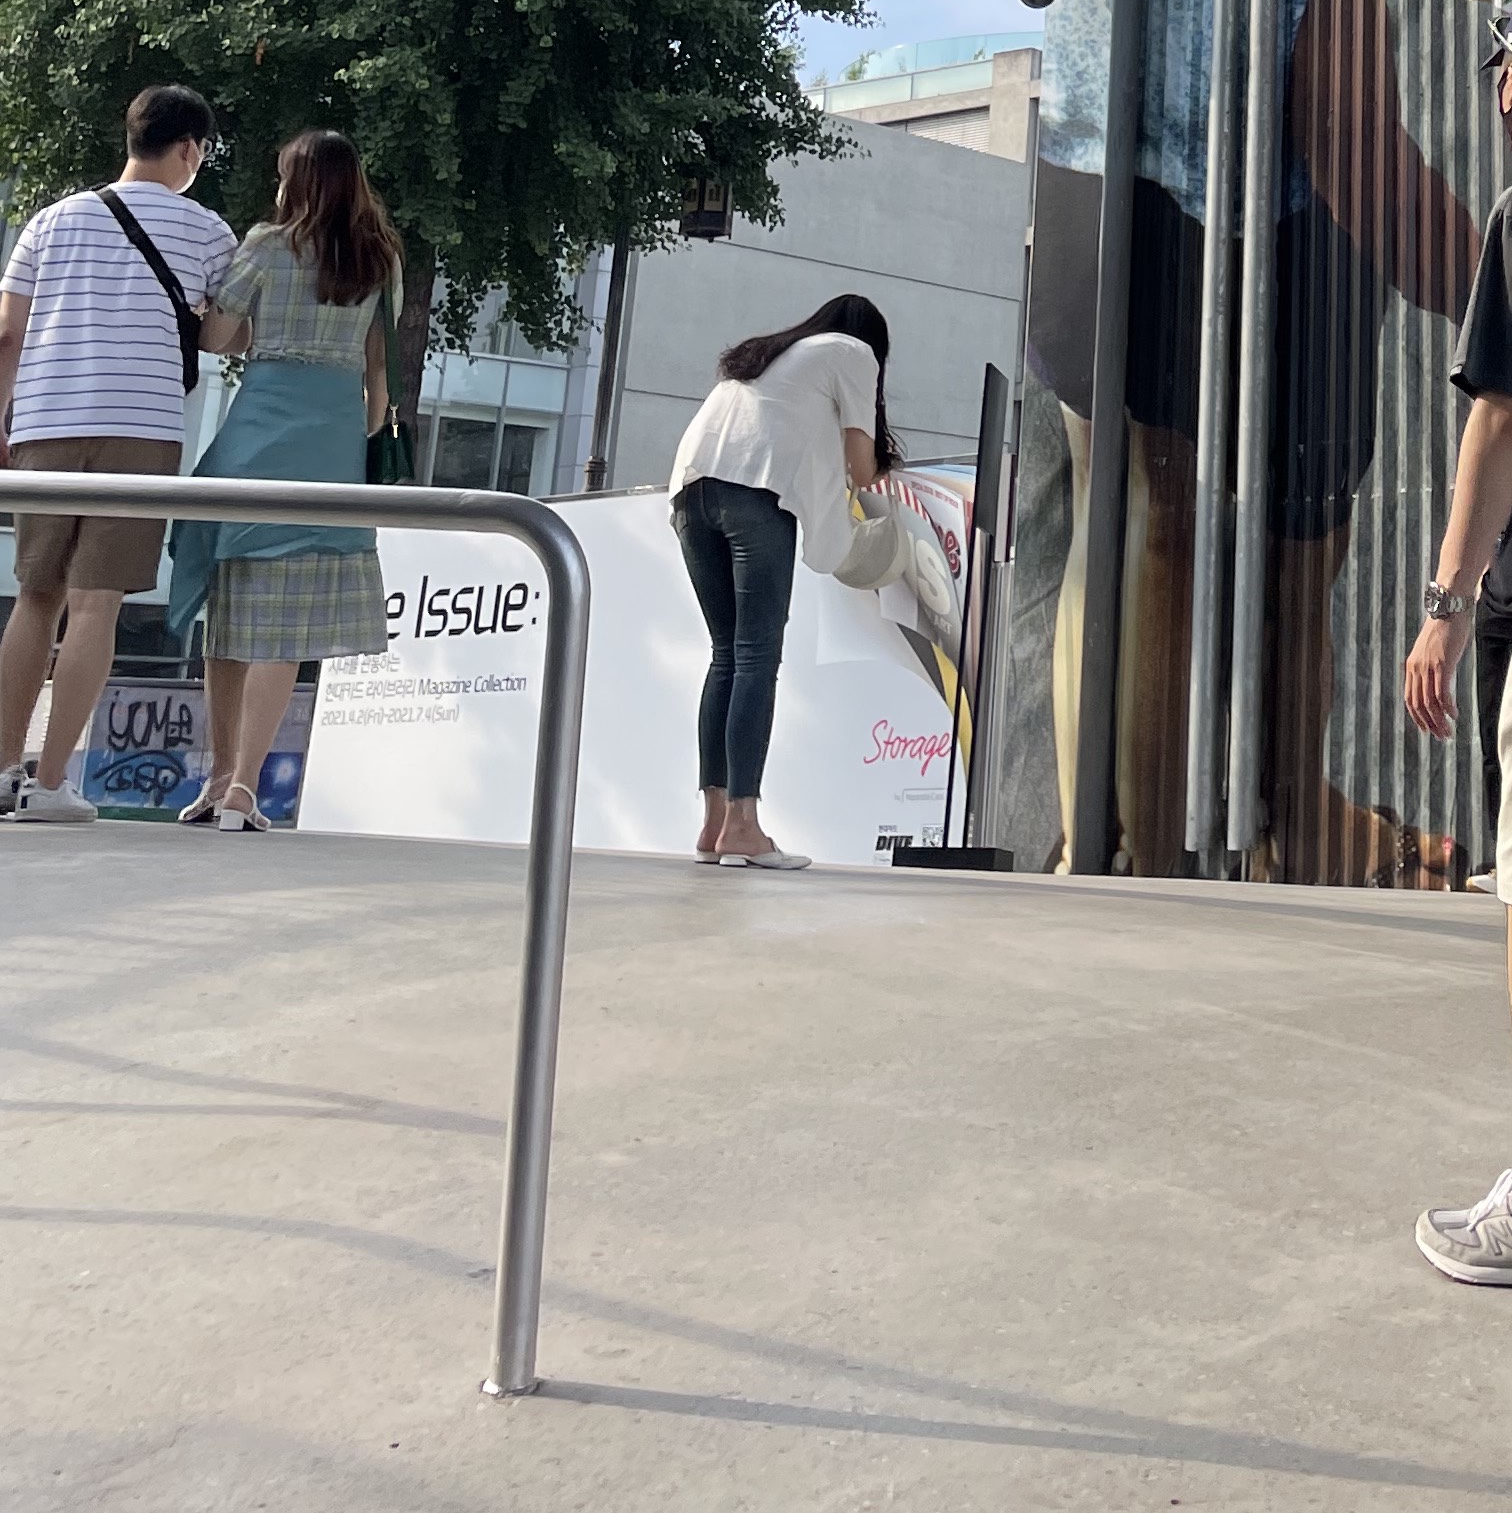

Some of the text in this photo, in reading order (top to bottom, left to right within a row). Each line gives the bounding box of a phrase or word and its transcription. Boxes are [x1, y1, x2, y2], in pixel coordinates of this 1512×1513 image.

[415, 575, 540, 638] Issue:
[366, 678, 416, 699] 라이브러리
[417, 677, 472, 700] Magazine
[474, 673, 528, 694] Collection
[863, 719, 952, 776] Storage
